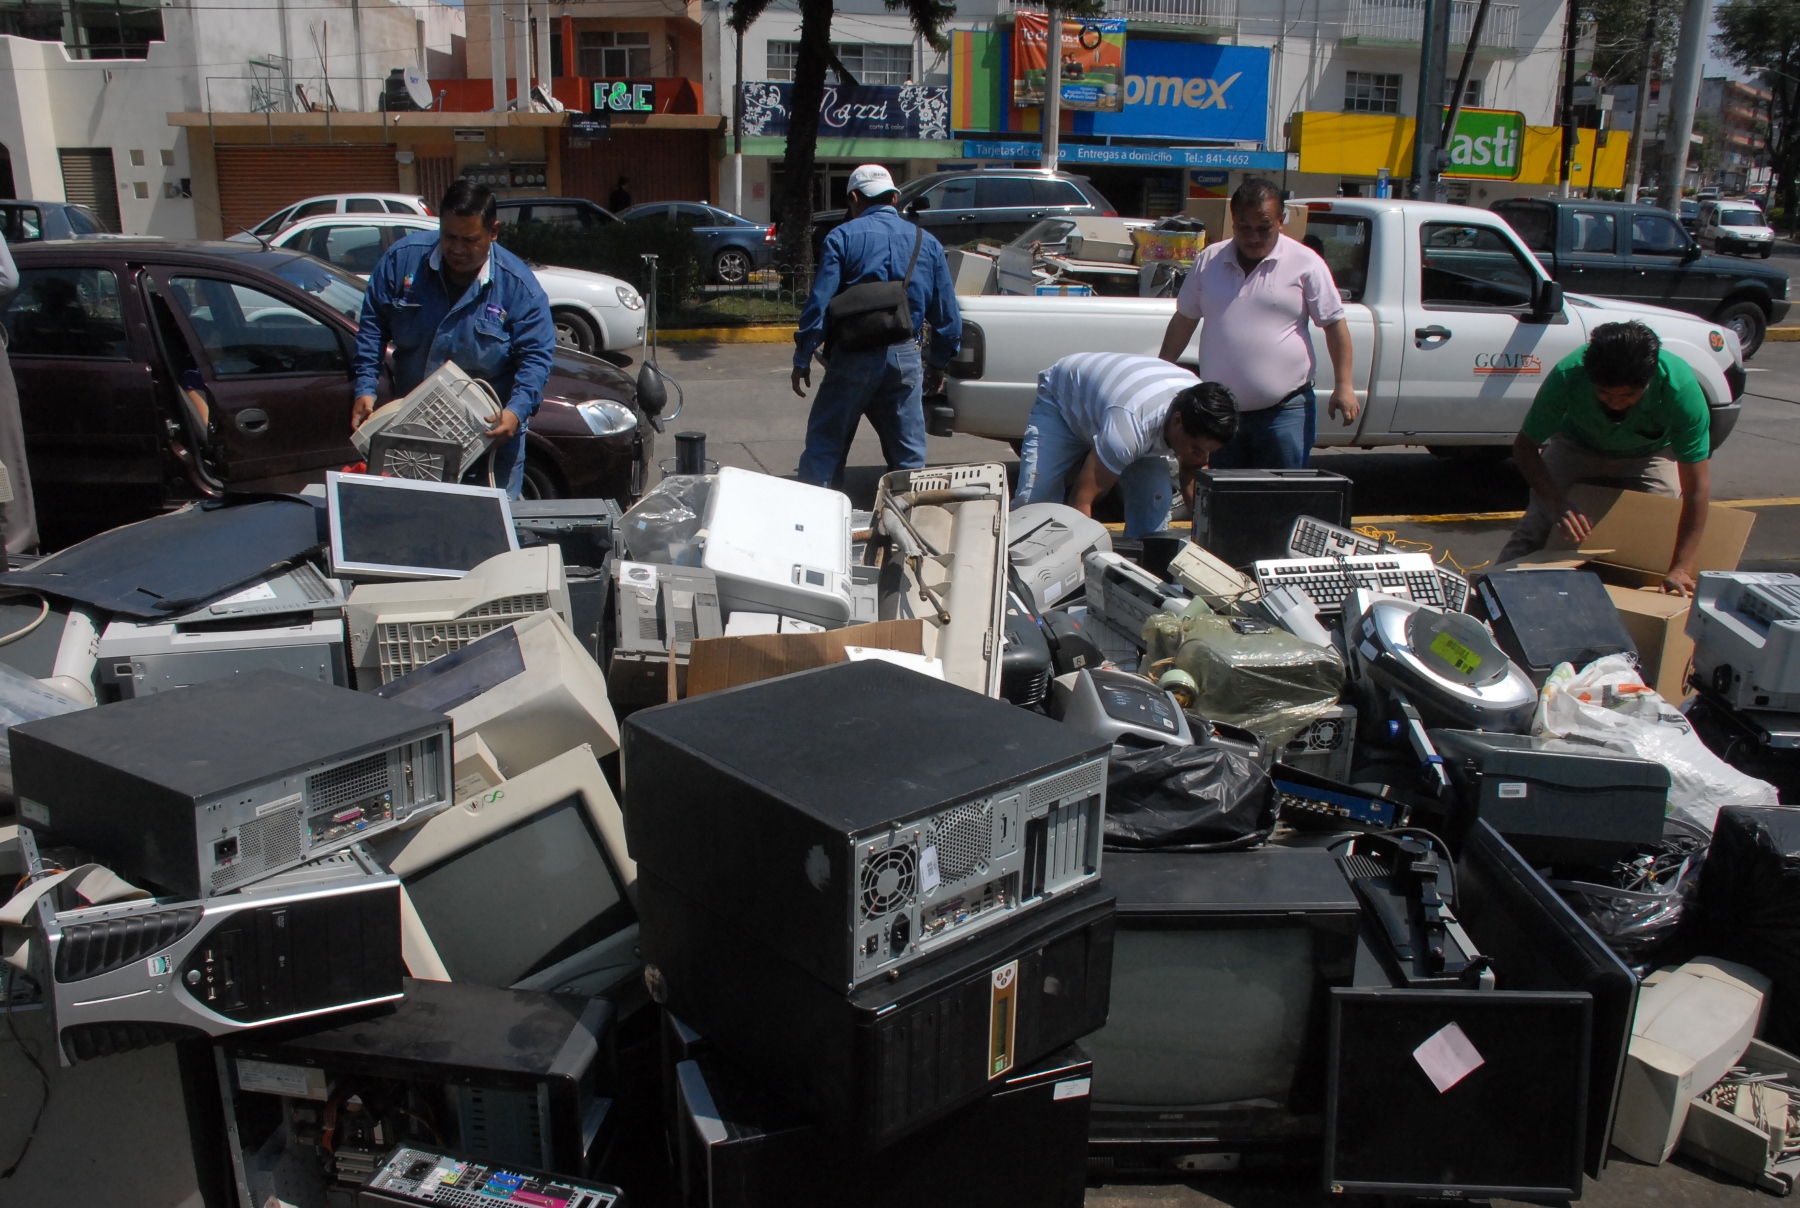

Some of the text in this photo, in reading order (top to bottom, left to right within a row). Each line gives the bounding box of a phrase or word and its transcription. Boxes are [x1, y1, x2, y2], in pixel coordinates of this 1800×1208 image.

[1021, 28, 1033, 39] Te
[594, 82, 653, 110] F&E
[1123, 71, 1243, 110] omex
[976, 145, 1015, 157] Tarjetas
[1017, 146, 1029, 156] de
[1451, 126, 1519, 167] asti
[1078, 148, 1173, 163] Entregas a domicilio
[1184, 152, 1249, 165] Tel.: 841-4652
[1198, 175, 1224, 184] Comex
